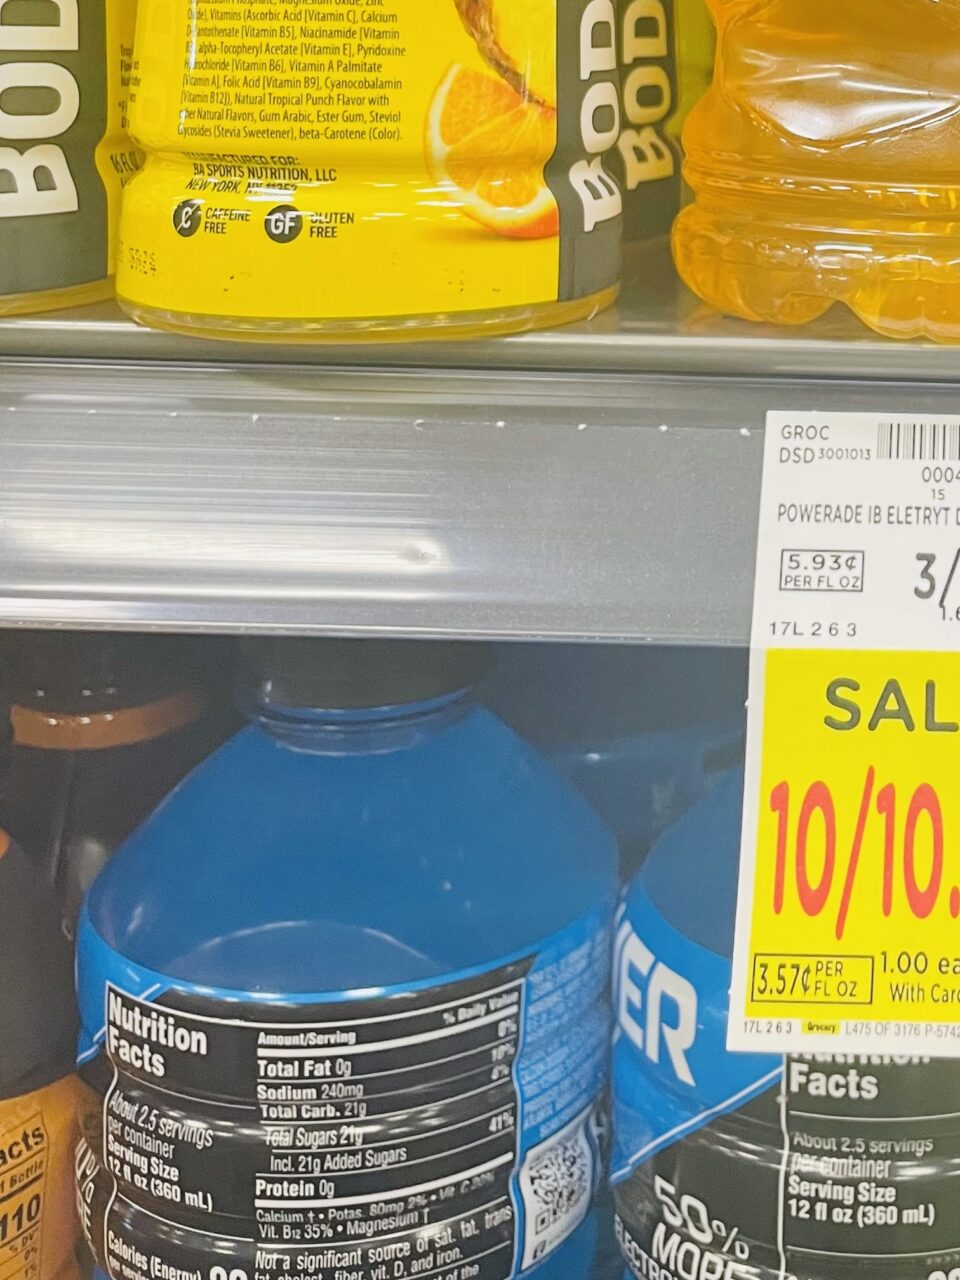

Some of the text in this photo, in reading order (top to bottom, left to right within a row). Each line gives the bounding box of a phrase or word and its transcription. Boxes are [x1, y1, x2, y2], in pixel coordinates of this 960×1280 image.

[234, 93, 390, 108] Natural Tropical Punch Flavor with
[299, 126, 367, 141] beta-Carotene
[207, 164, 337, 183] SPORTS NUTRITION, LLC
[204, 221, 227, 235] FREE
[270, 211, 296, 236] GF
[309, 226, 337, 239] FREE
[781, 424, 830, 441] GROC
[779, 447, 872, 464] DSD 3001013
[931, 489, 946, 501] 15
[777, 503, 863, 524] POWERADE
[887, 505, 950, 526] ELETRYT
[787, 553, 857, 571] 5.93¢
[784, 574, 860, 589] PER FL OZ
[769, 621, 804, 637] 17L
[880, 951, 928, 975] 1.00
[757, 960, 843, 996] 3.57¢ PER
[814, 981, 857, 997] FL OZ
[889, 982, 925, 1004] With
[108, 991, 208, 1055] Nutrition
[743, 1021, 762, 1034] 17L
[845, 1022, 871, 1036] L475
[875, 1023, 891, 1036] OF
[894, 1023, 921, 1038] 3176
[257, 1030, 357, 1047] Amount/Serving
[108, 1025, 166, 1077] Facts
[257, 1058, 352, 1078] Total Fat 0g
[789, 1062, 879, 1100] Facts
[257, 1083, 364, 1101] Sodium 240mg
[260, 1102, 367, 1120] Total Carb. 21g
[107, 1135, 180, 1183] Serving Size
[255, 1179, 335, 1199] Protein 0g
[788, 1178, 897, 1204] Serving Size
[654, 1174, 750, 1261] 50%
